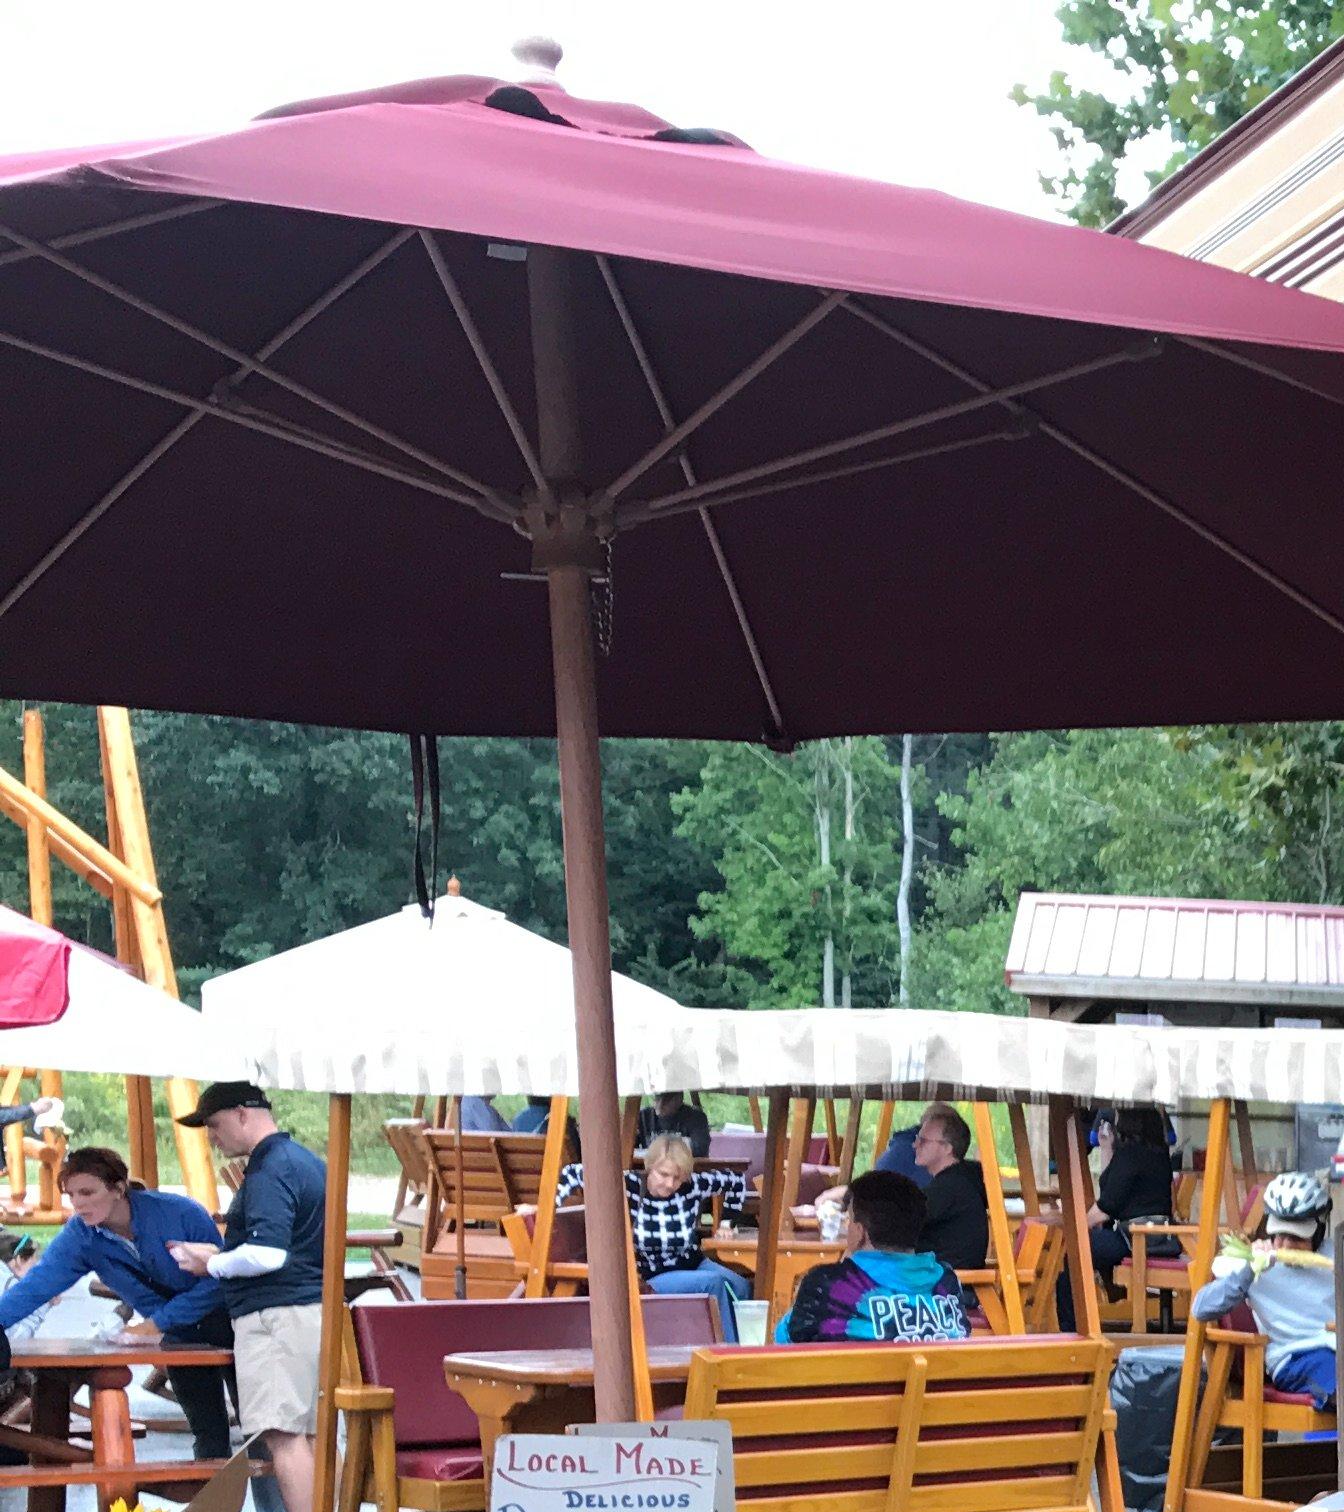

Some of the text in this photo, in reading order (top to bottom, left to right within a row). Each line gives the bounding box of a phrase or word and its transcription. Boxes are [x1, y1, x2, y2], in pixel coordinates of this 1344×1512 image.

[869, 1294, 967, 1340] PEACE
[508, 1440, 712, 1477] LOCAL MADE
[563, 1490, 690, 1509] DELICIOUS
